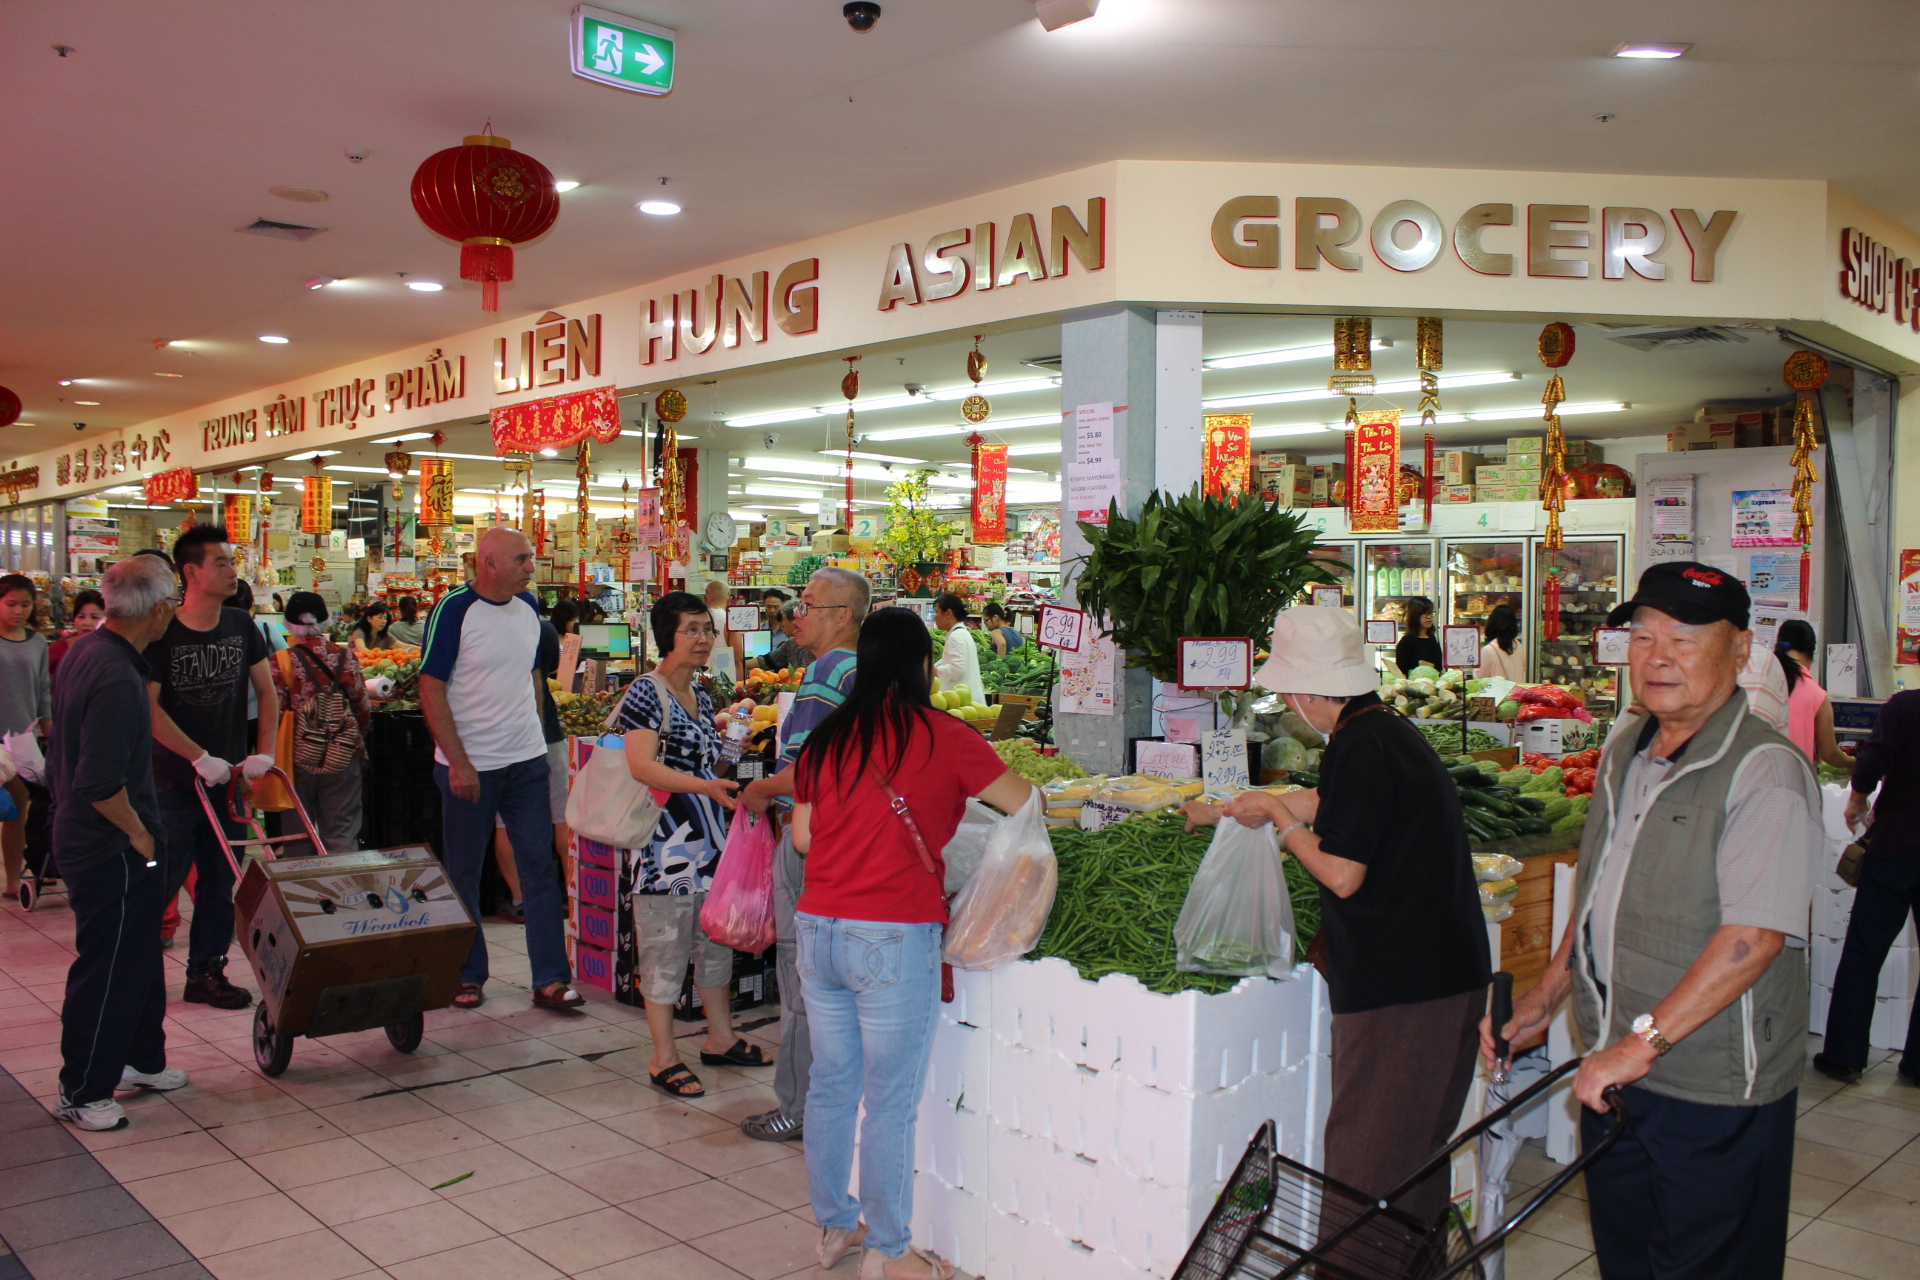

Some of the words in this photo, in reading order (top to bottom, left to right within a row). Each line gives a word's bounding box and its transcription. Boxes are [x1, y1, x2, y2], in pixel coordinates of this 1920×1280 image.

[1841, 227, 1898, 316] SHOP
[493, 310, 602, 394] LIÊN
[639, 258, 819, 365] HƯNG
[878, 197, 1106, 311] ASIAN
[1211, 195, 1739, 283] GROCERY
[198, 409, 257, 452] TRUNG
[263, 394, 306, 438] TÂM
[312, 378, 375, 430] THỰC
[384, 348, 465, 414] PHẨM
[1086, 431, 1101, 439] $5.80
[1086, 456, 1101, 465] $4.99
[770, 520, 782, 536] 3
[1477, 512, 1488, 527] 4
[858, 520, 871, 537] 2
[444, 537, 452, 550] 6
[1651, 548, 1677, 556] BLACK
[1691, 579, 1711, 589] zero
[171, 644, 244, 678] STANDARD
[1213, 730, 1233, 738] SALE
[584, 873, 610, 900] Q10
[342, 911, 431, 936] Wombok
[585, 914, 610, 940] Q10
[582, 954, 607, 979] Q10
